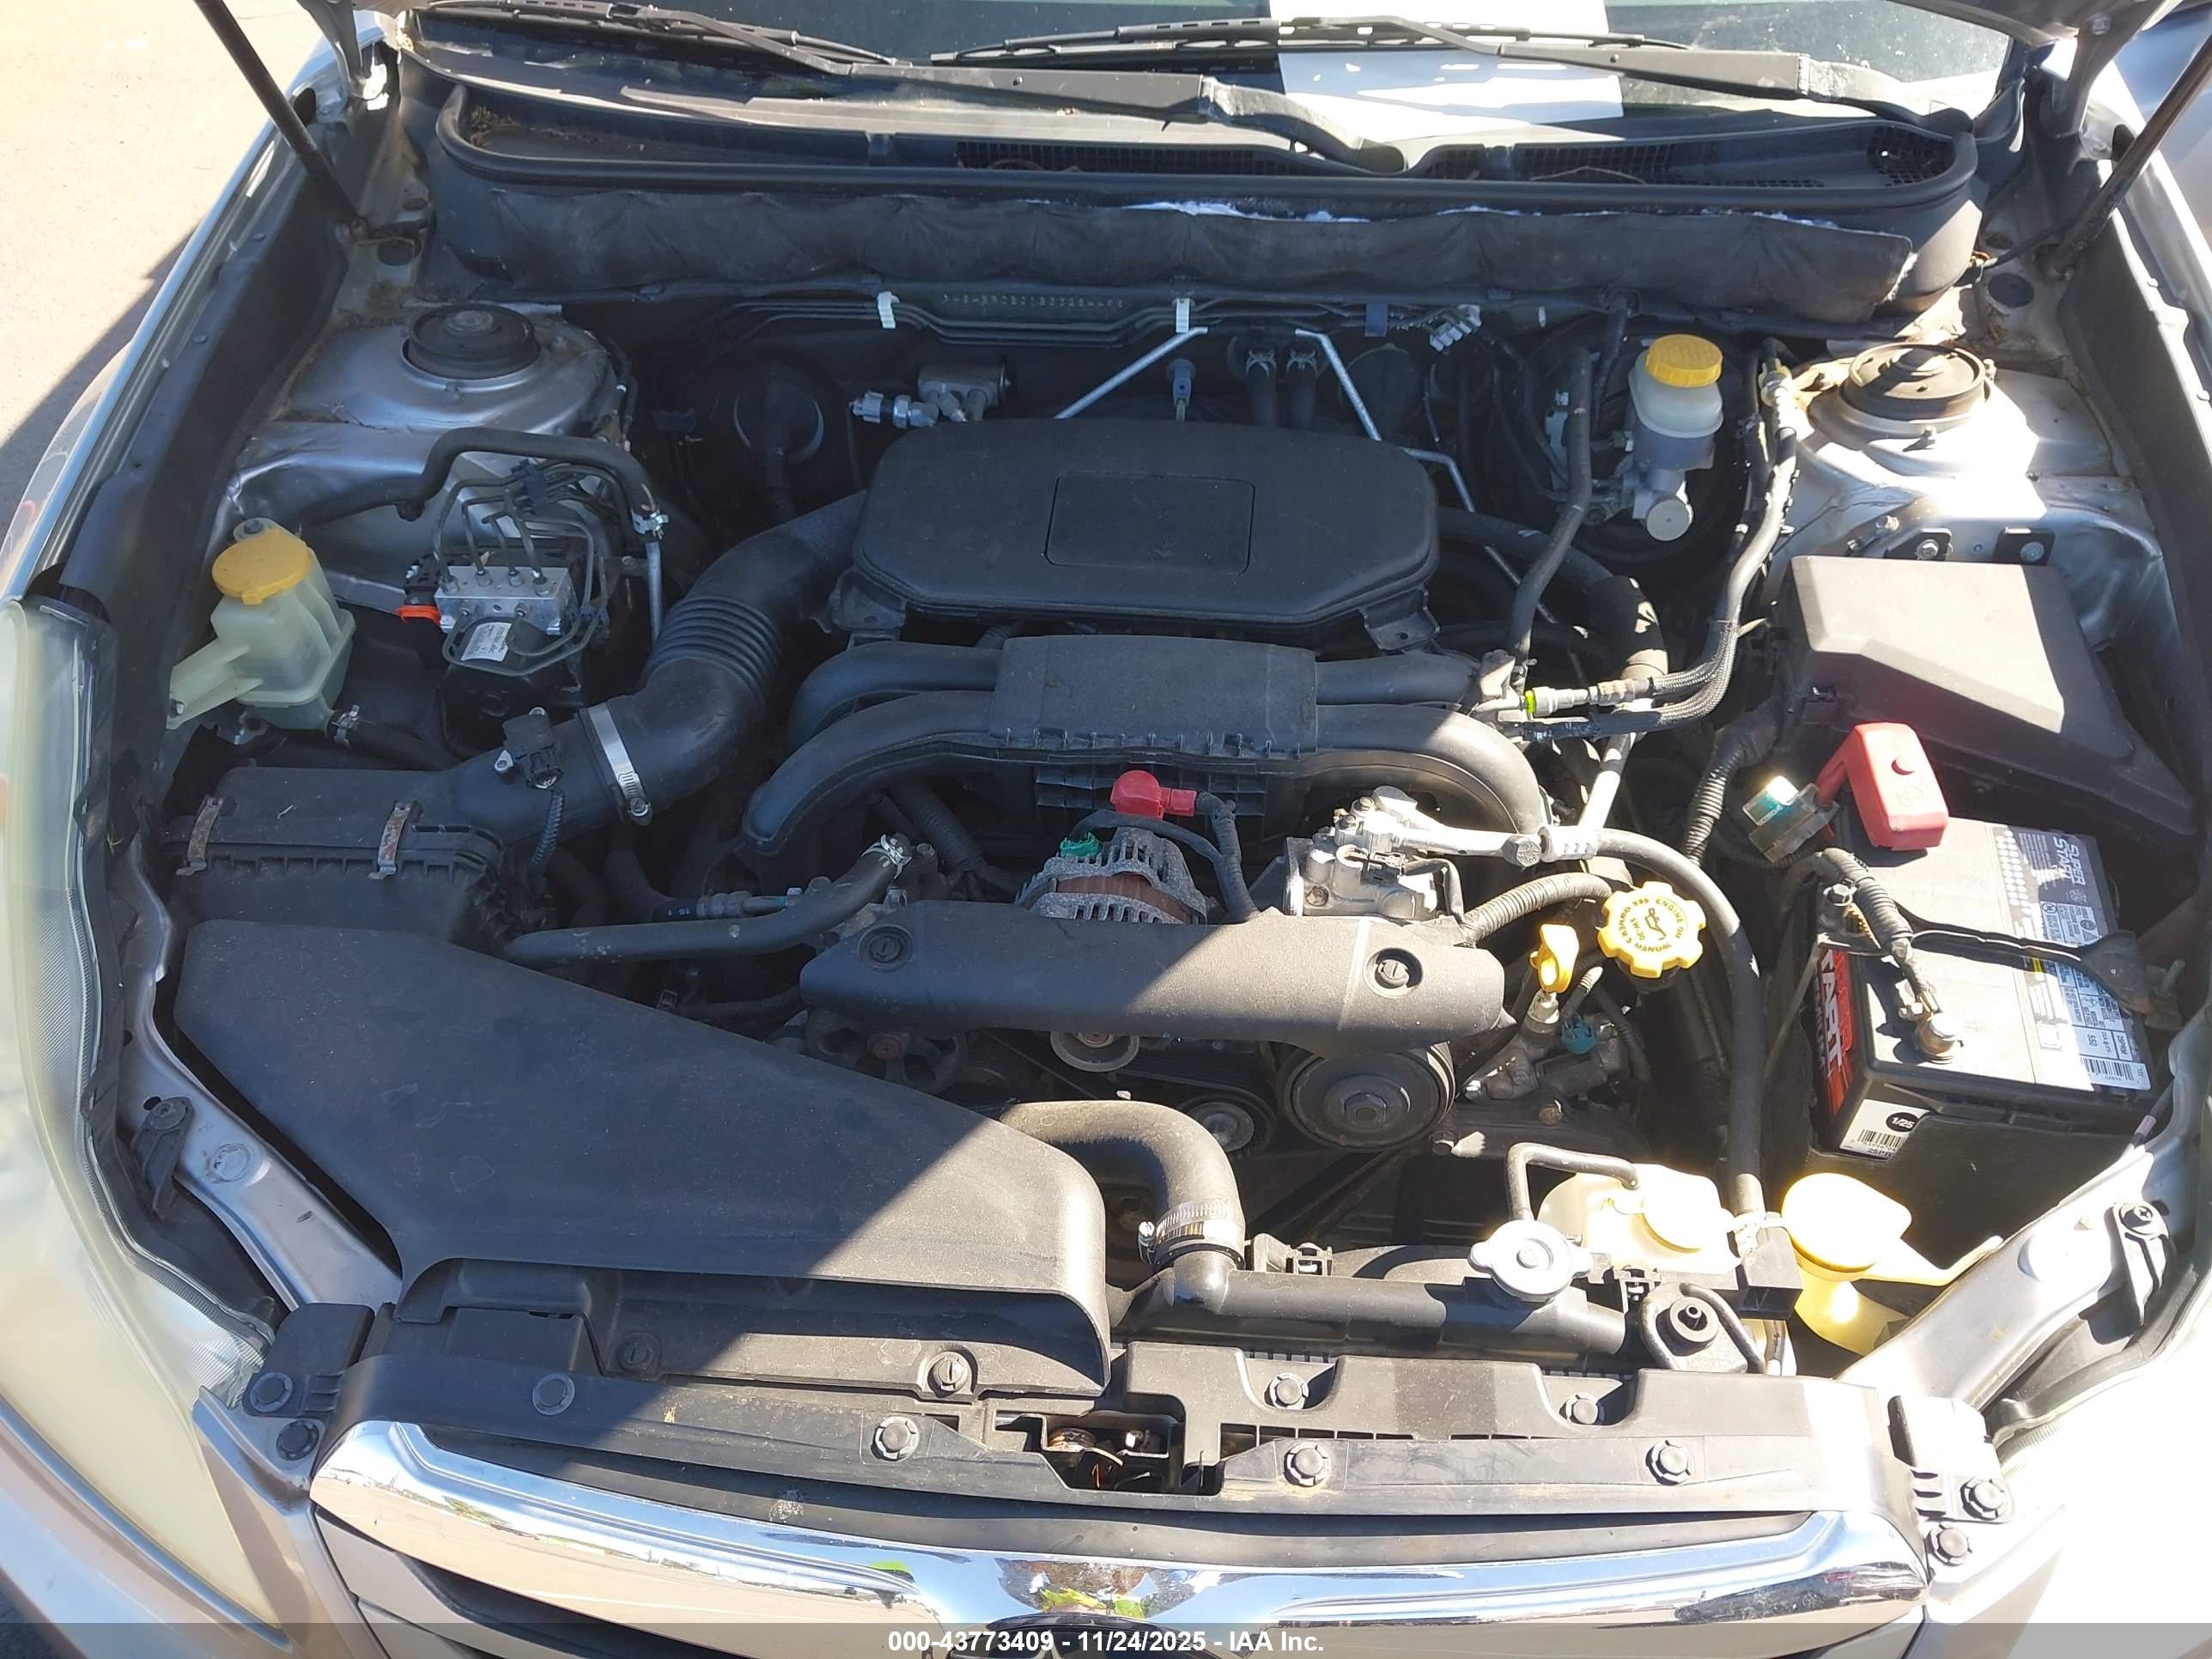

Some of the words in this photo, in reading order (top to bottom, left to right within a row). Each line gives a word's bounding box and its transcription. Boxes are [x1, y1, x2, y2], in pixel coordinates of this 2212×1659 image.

[2053, 836, 2075, 884] START
[2068, 844, 2086, 885] SUPER
[1655, 898, 1684, 923] ENGINE
[1634, 942, 1672, 952] MANUAL
[1821, 949, 1843, 1072] TART
[1892, 1117, 1915, 1129] 1/25
[1867, 1147, 1894, 1158] 25PR
